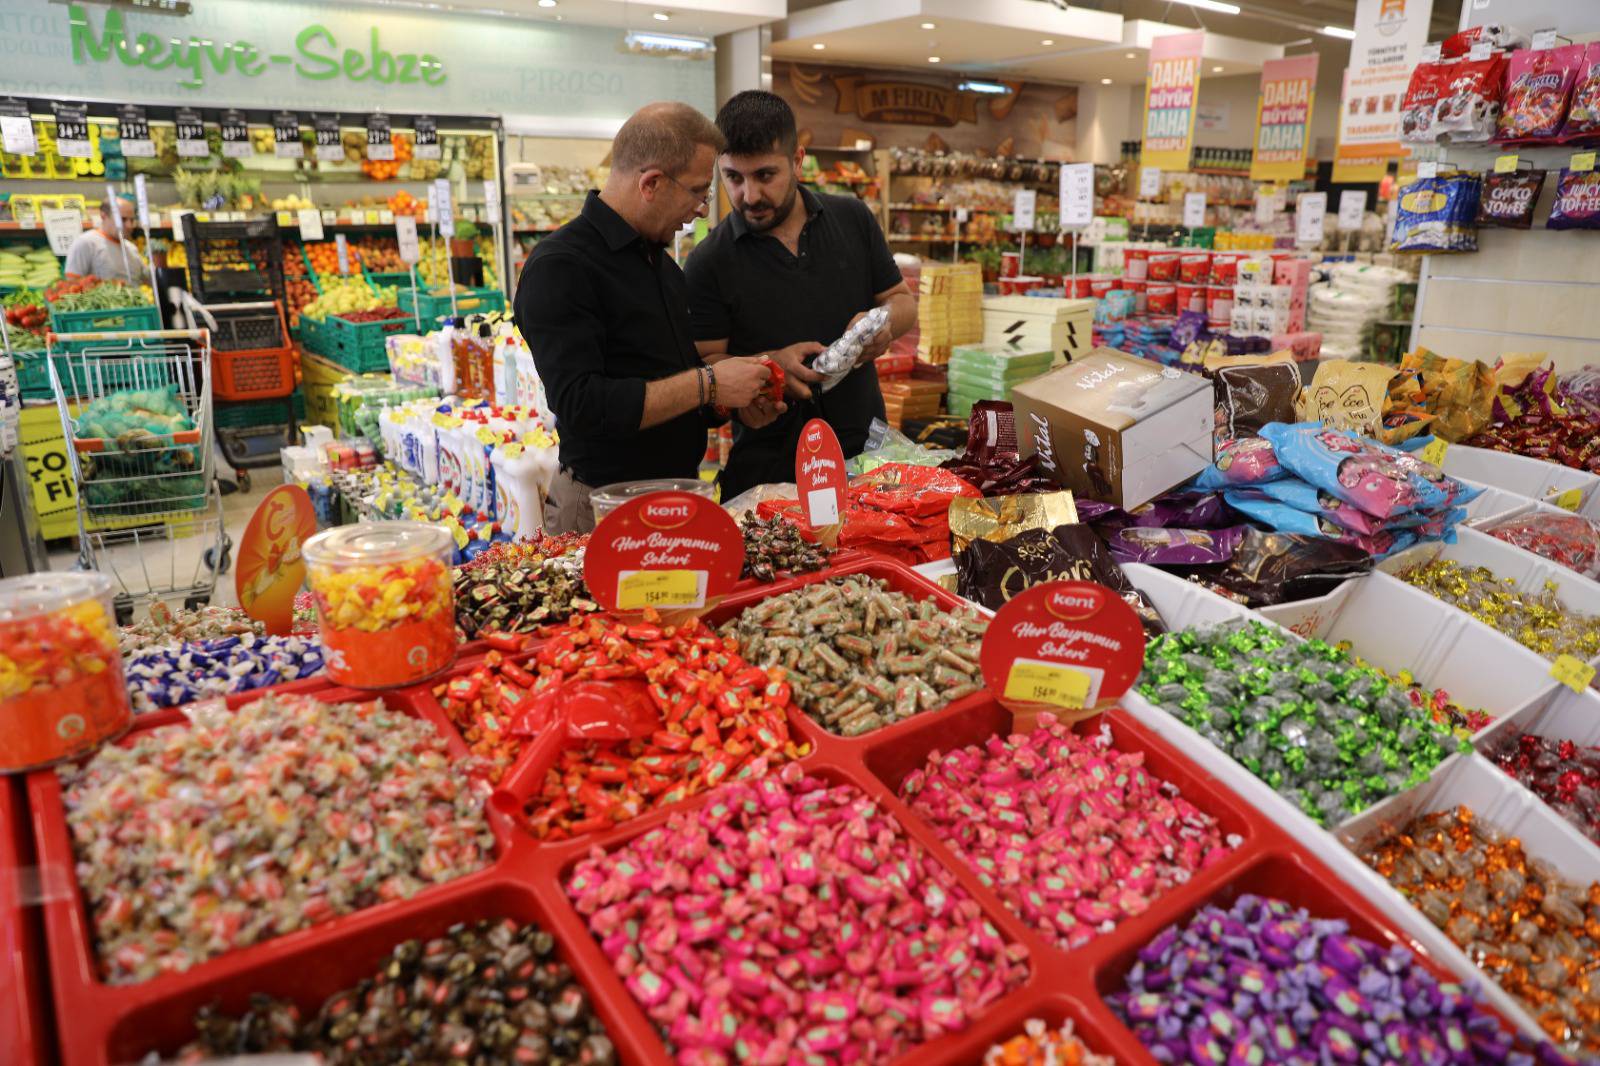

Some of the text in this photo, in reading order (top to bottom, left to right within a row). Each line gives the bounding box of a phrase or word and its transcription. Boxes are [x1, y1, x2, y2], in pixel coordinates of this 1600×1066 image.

[68, 4, 447, 89] Meyve-Sebze
[1151, 59, 1194, 87] DAHA
[1150, 89, 1192, 107] BÜYÜK
[1264, 80, 1308, 106] DAHA
[1147, 108, 1189, 138] DAHA
[1262, 106, 1305, 123] BÜYÜK
[1259, 124, 1303, 150] DAHA
[1487, 200, 1529, 216] TOFFEE
[647, 504, 689, 517] kent
[611, 532, 721, 553] Her Bayramın
[1052, 593, 1096, 609] kent
[1012, 621, 1121, 652] Her Bayramın
